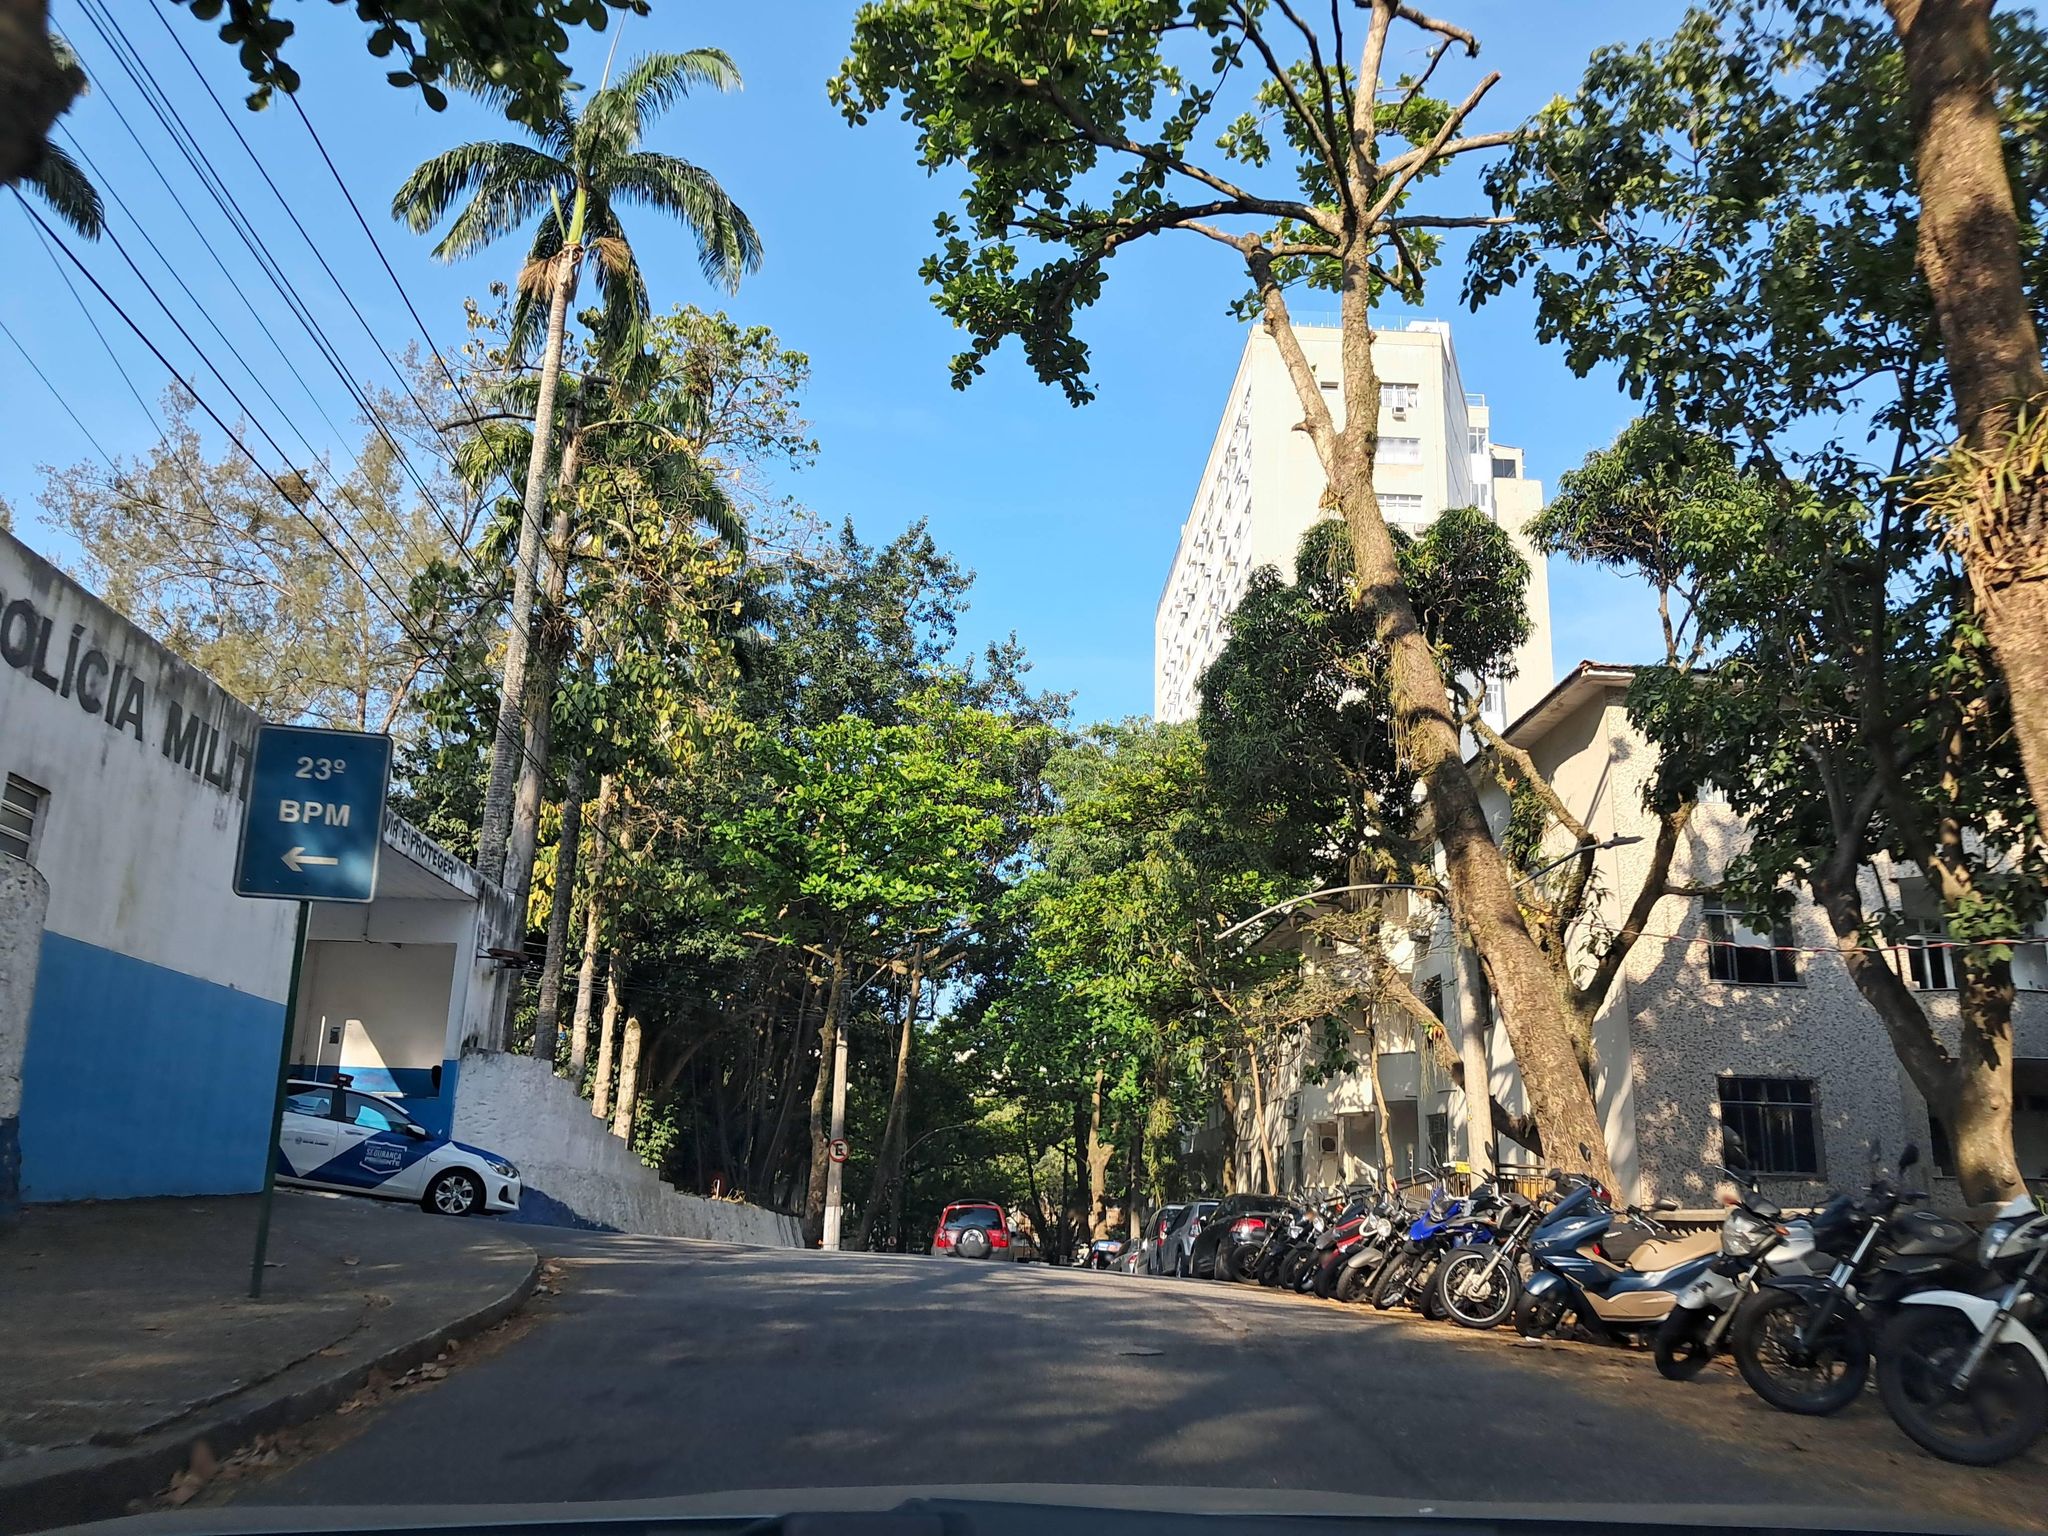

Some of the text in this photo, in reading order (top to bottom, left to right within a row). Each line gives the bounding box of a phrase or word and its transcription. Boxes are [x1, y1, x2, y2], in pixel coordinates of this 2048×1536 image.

[0, 590, 144, 742] OLÍCIA
[295, 756, 346, 780] 23º
[279, 799, 350, 827] BPM
[410, 834, 454, 873] PROTEGER
